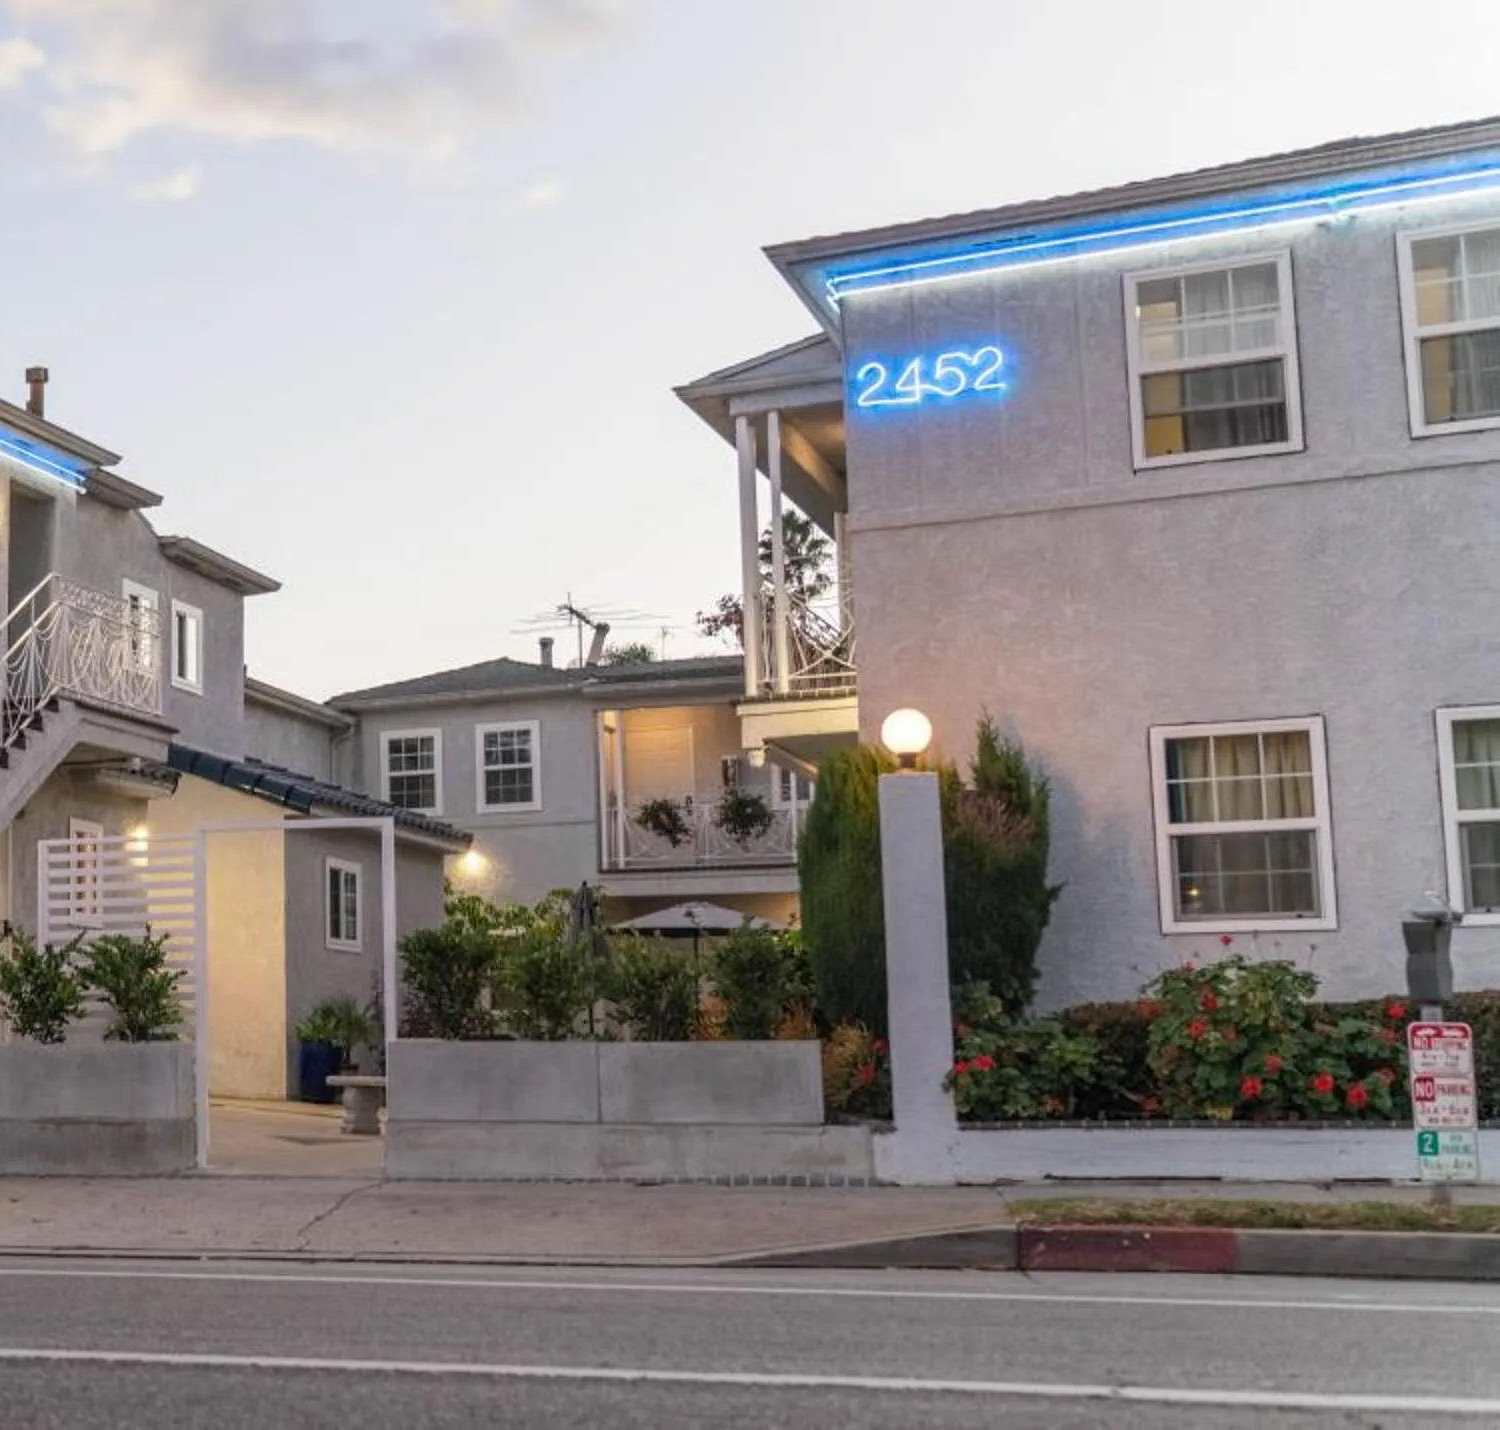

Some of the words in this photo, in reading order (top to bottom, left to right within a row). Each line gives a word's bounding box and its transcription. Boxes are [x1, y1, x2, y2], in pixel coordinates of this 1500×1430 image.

[857, 345, 1008, 407] 2452
[1415, 1080, 1434, 1099] NO
[1422, 1133, 1435, 1153] 2
